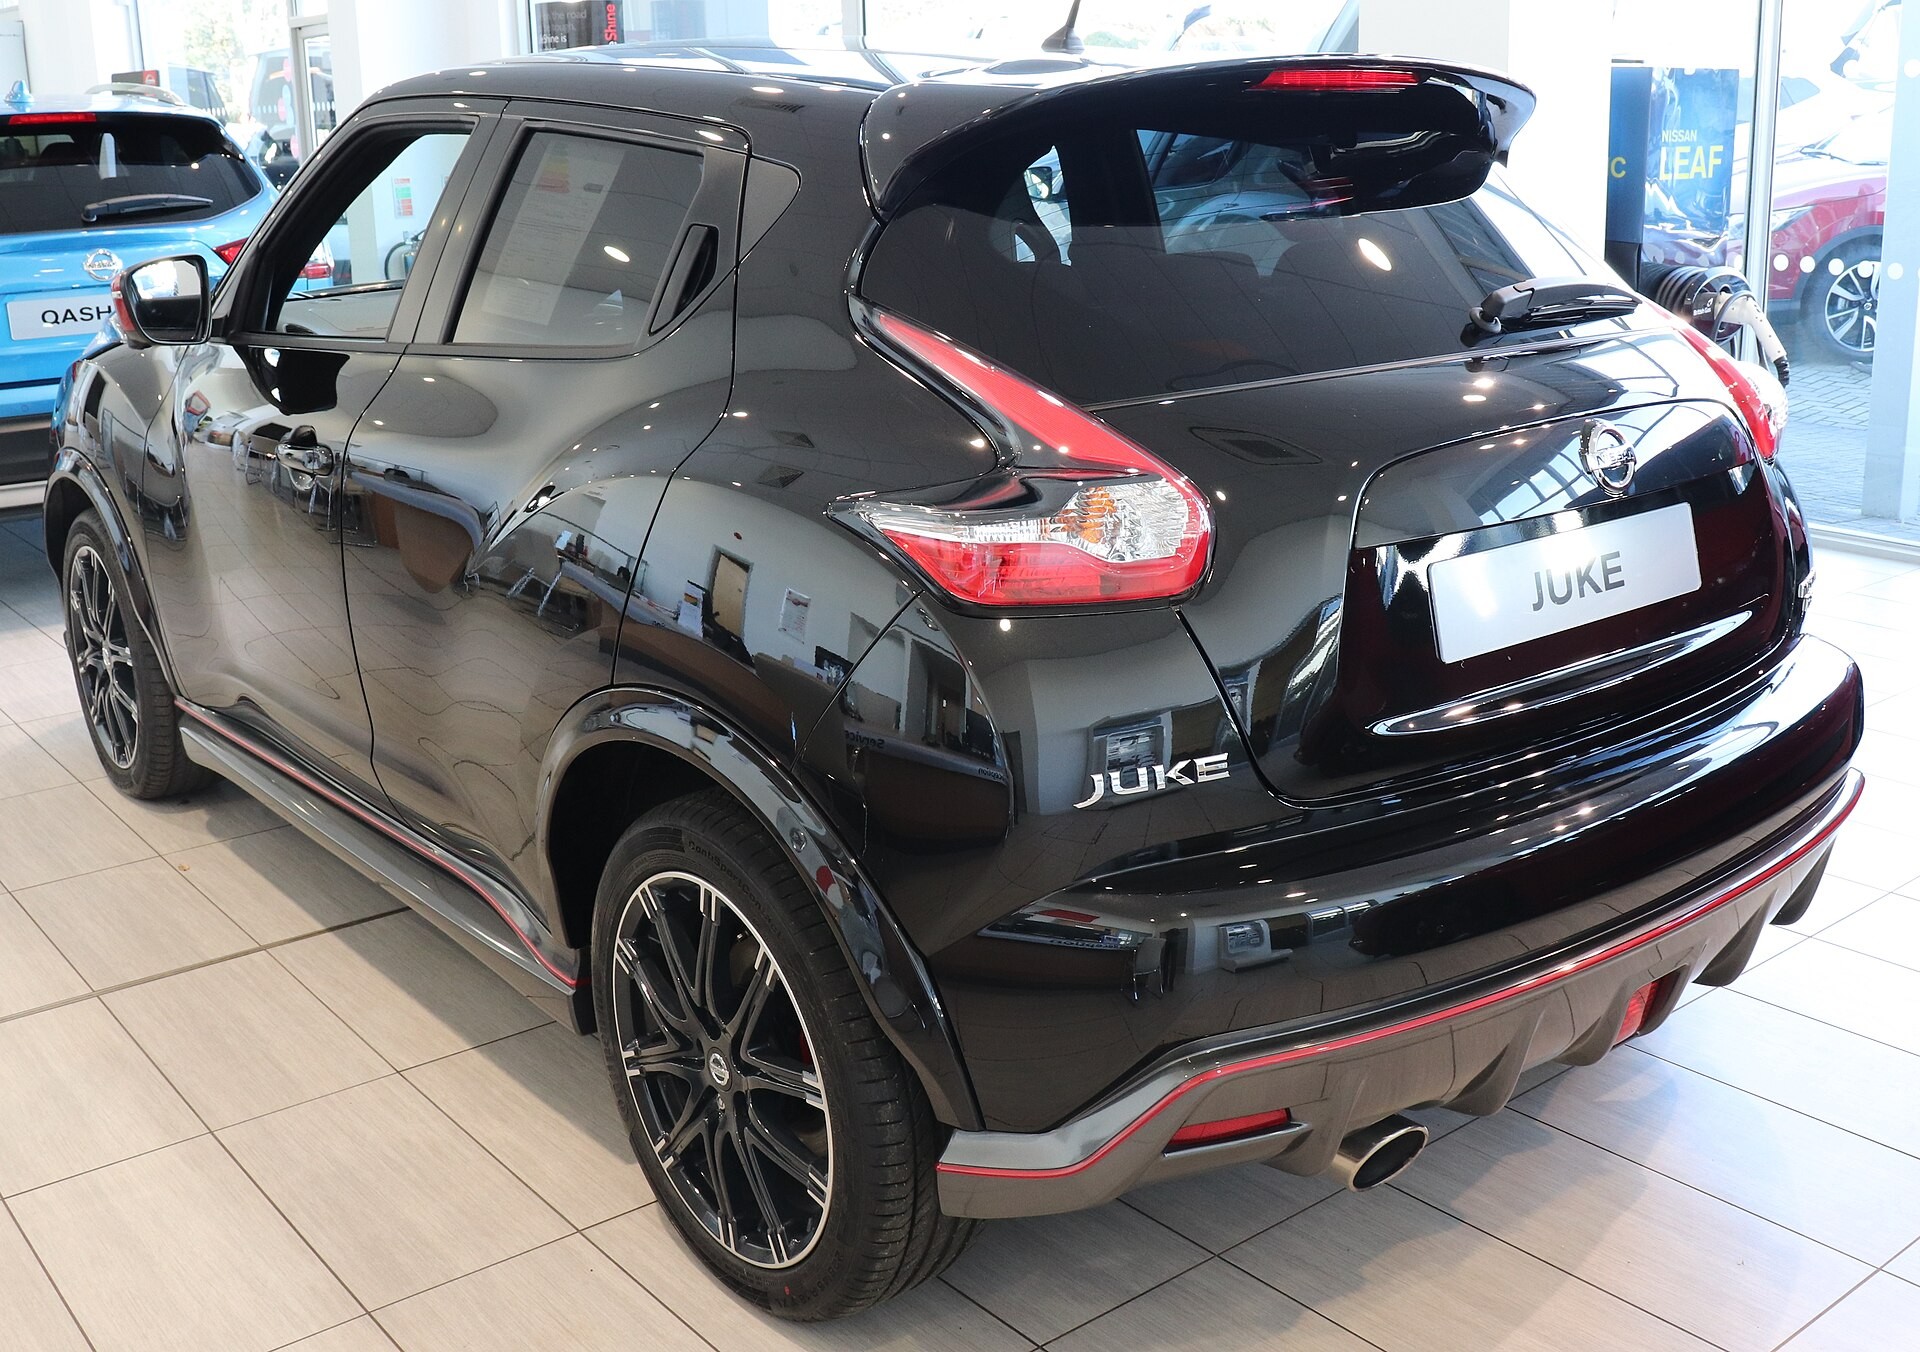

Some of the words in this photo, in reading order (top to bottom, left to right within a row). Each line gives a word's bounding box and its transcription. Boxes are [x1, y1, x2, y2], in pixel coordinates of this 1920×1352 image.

[1661, 129, 1698, 142] NISSAN
[1659, 144, 1724, 181] LEAF
[1532, 551, 1625, 611] JUKE
[1072, 752, 1231, 809] JUKE
